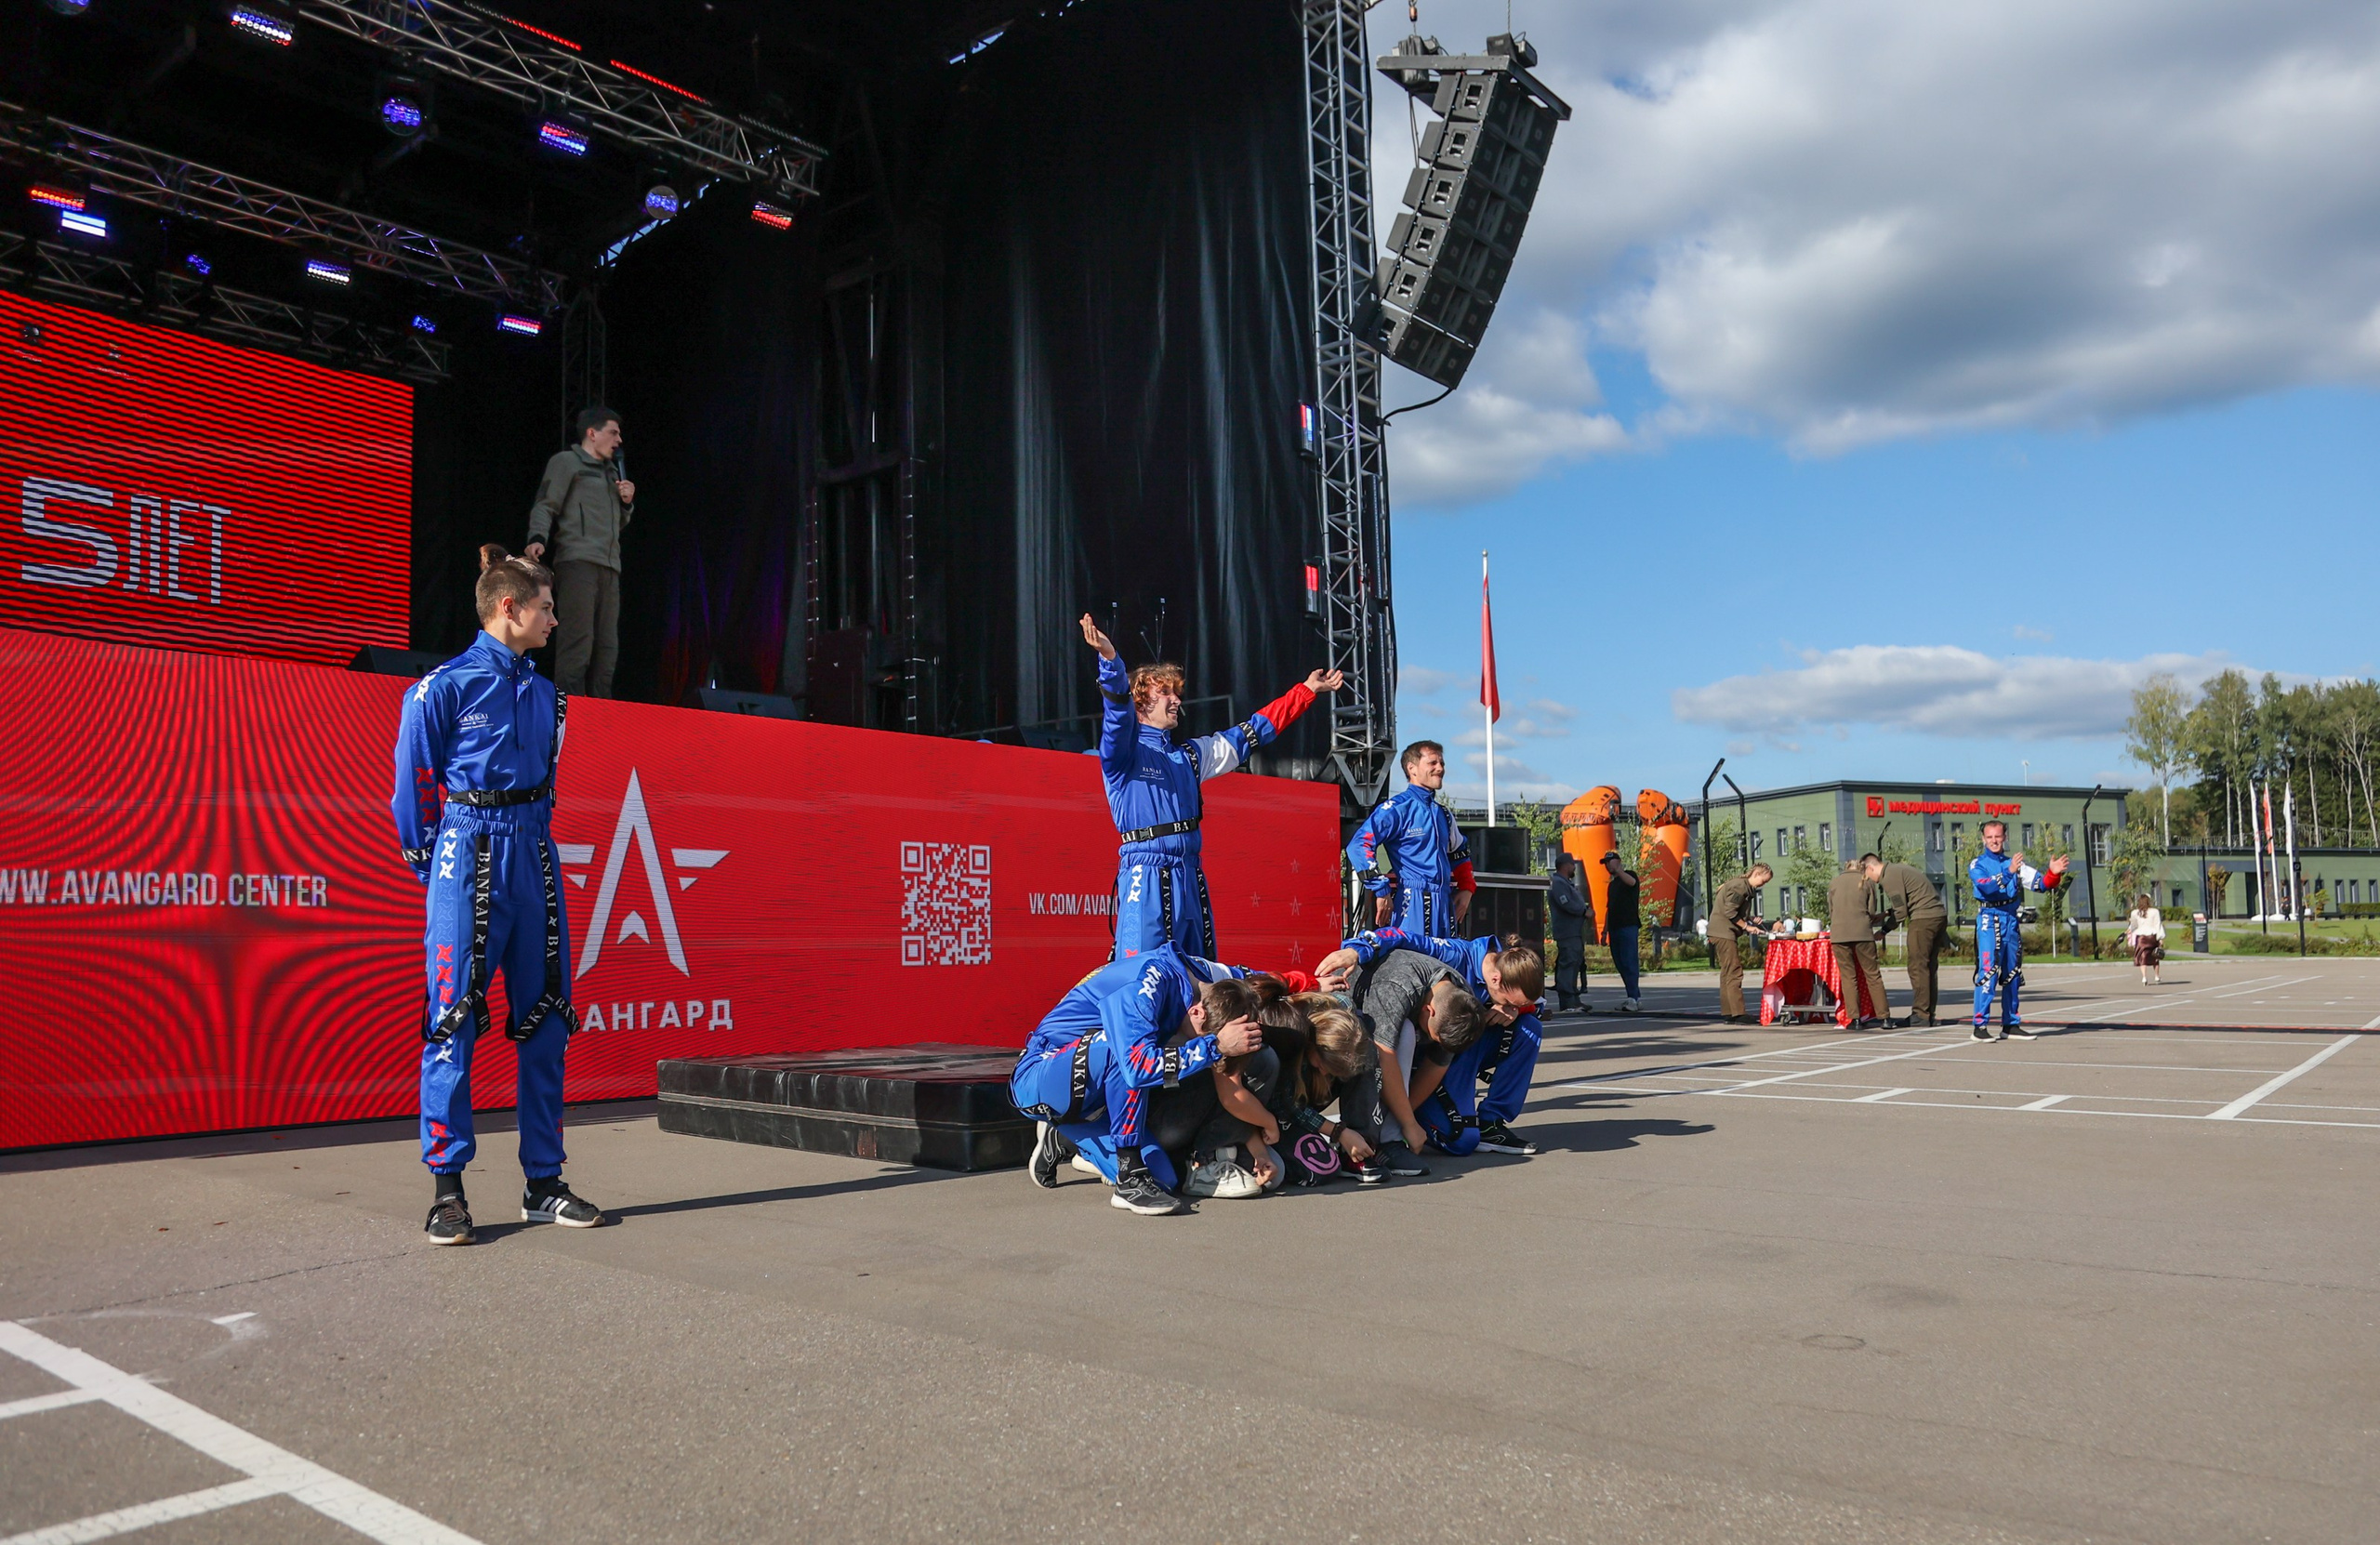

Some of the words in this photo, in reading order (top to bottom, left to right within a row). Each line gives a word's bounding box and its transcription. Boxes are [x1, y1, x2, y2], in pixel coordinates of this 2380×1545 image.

[21, 476, 119, 588] 5
[123, 494, 231, 604] ЛЕТ
[1888, 799, 1980, 816] медицинский
[1984, 802, 2022, 818] пункт
[475, 852, 491, 926] BANKAI
